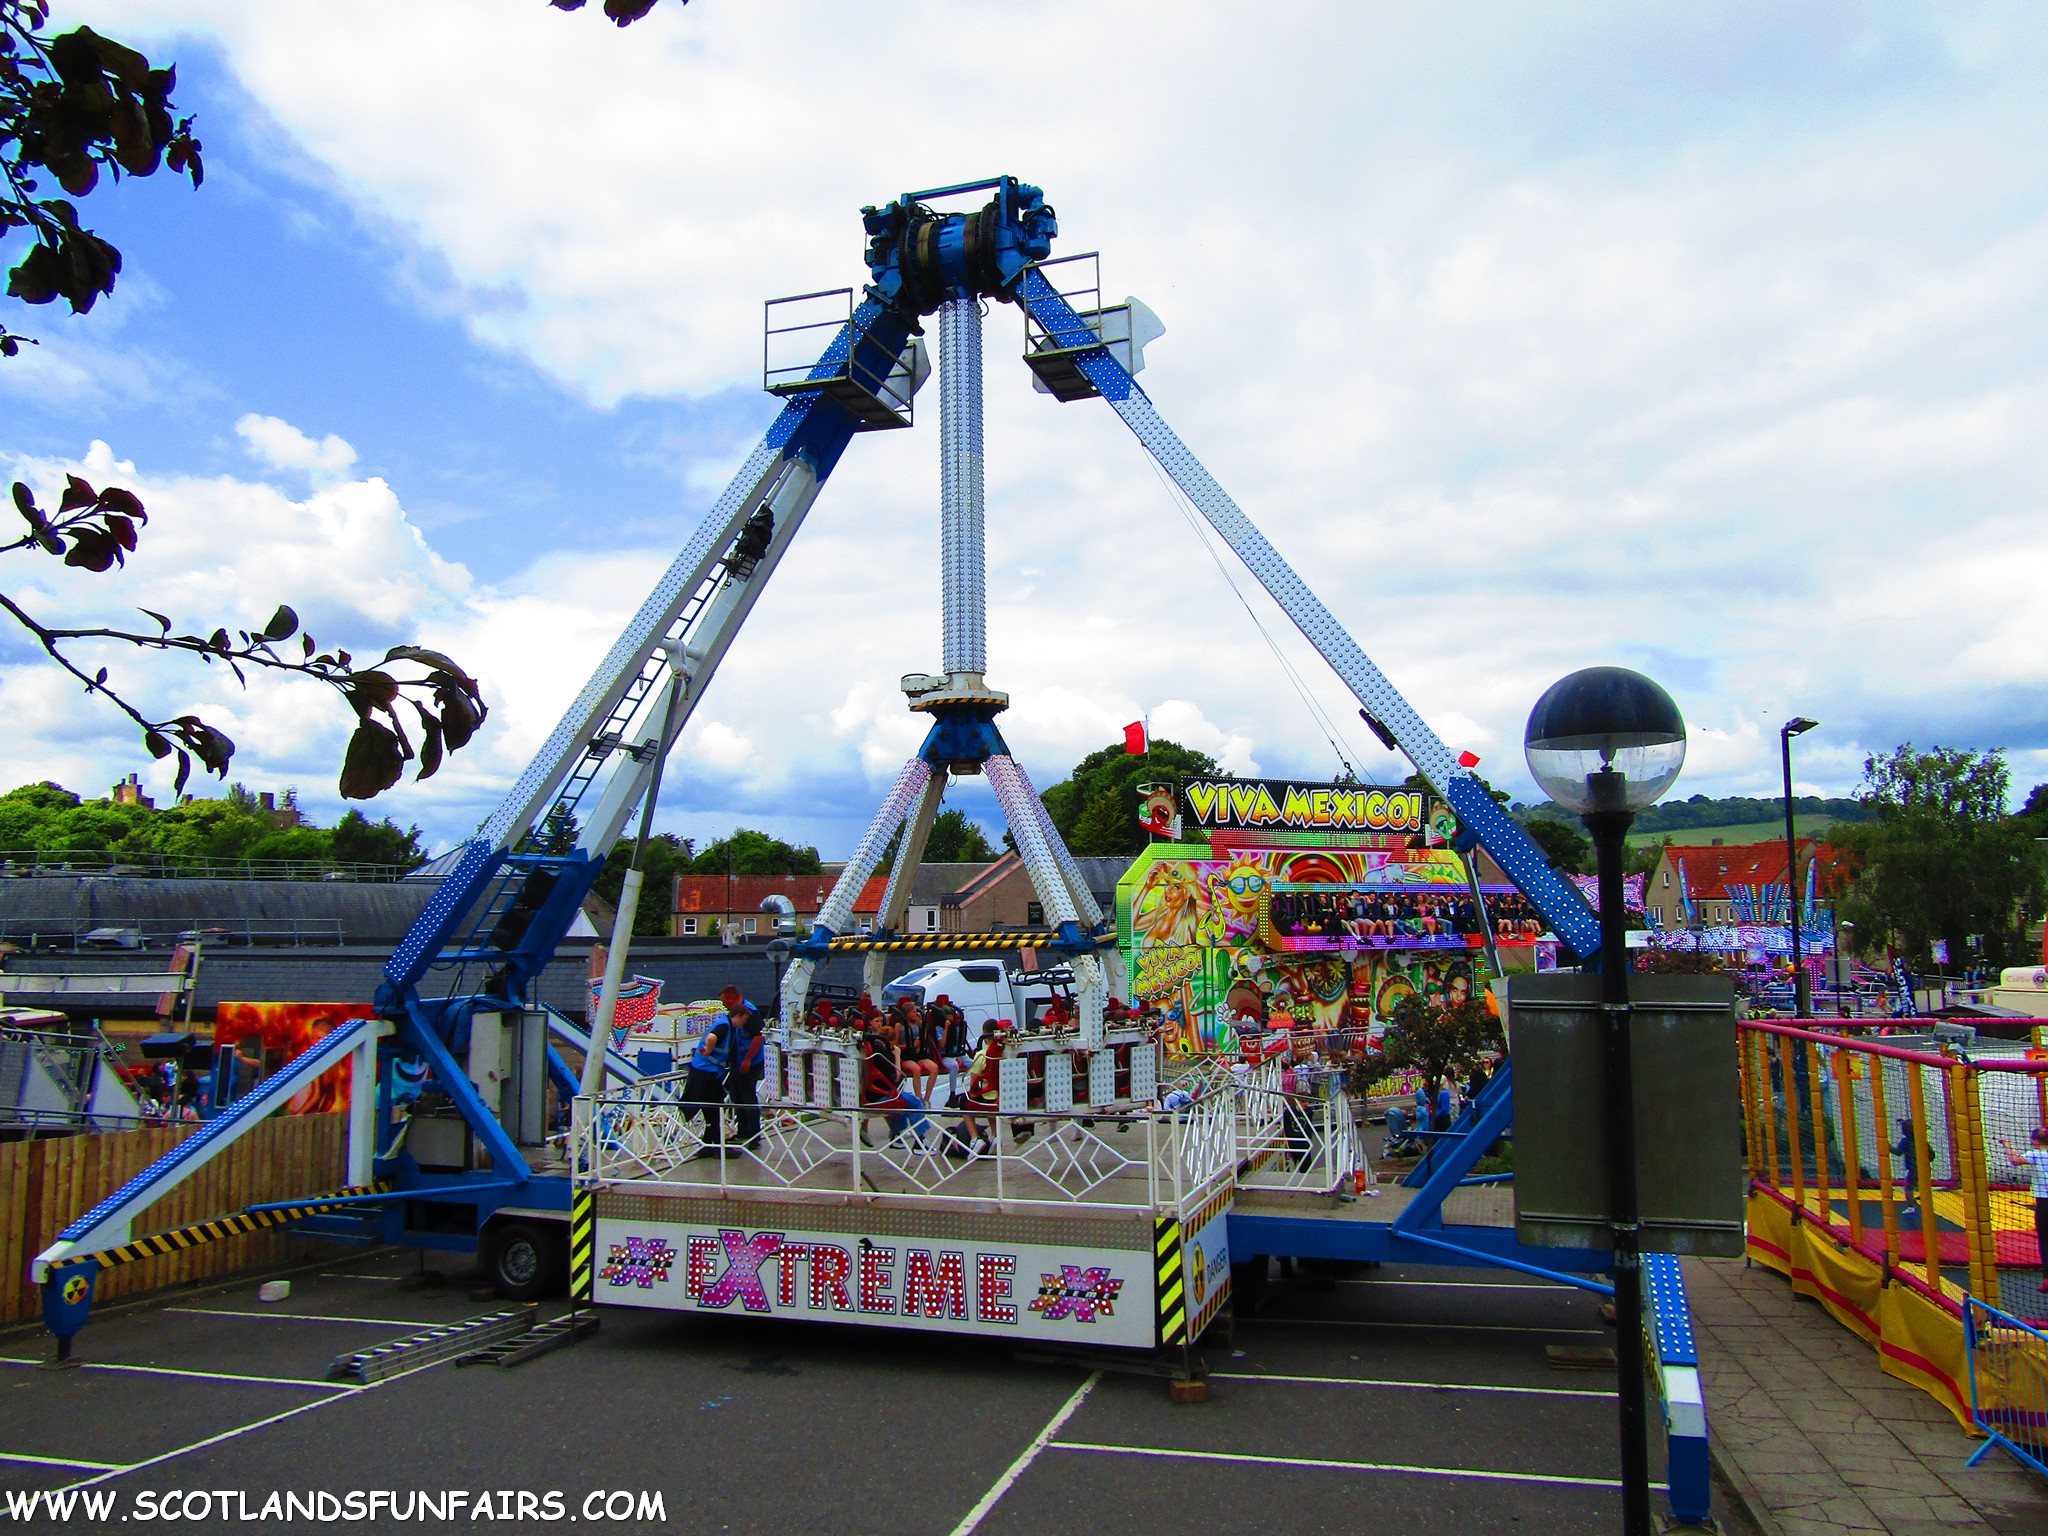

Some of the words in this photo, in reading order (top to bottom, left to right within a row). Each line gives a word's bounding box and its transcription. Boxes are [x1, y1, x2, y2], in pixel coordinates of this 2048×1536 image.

[1186, 781, 1280, 826] VIVA
[1281, 784, 1423, 832] MEXICO!
[1135, 950, 1204, 997] MEXICO!
[1136, 938, 1184, 972] VIVA
[685, 1229, 1018, 1325] EXTREME
[1207, 1247, 1227, 1284] DANGER
